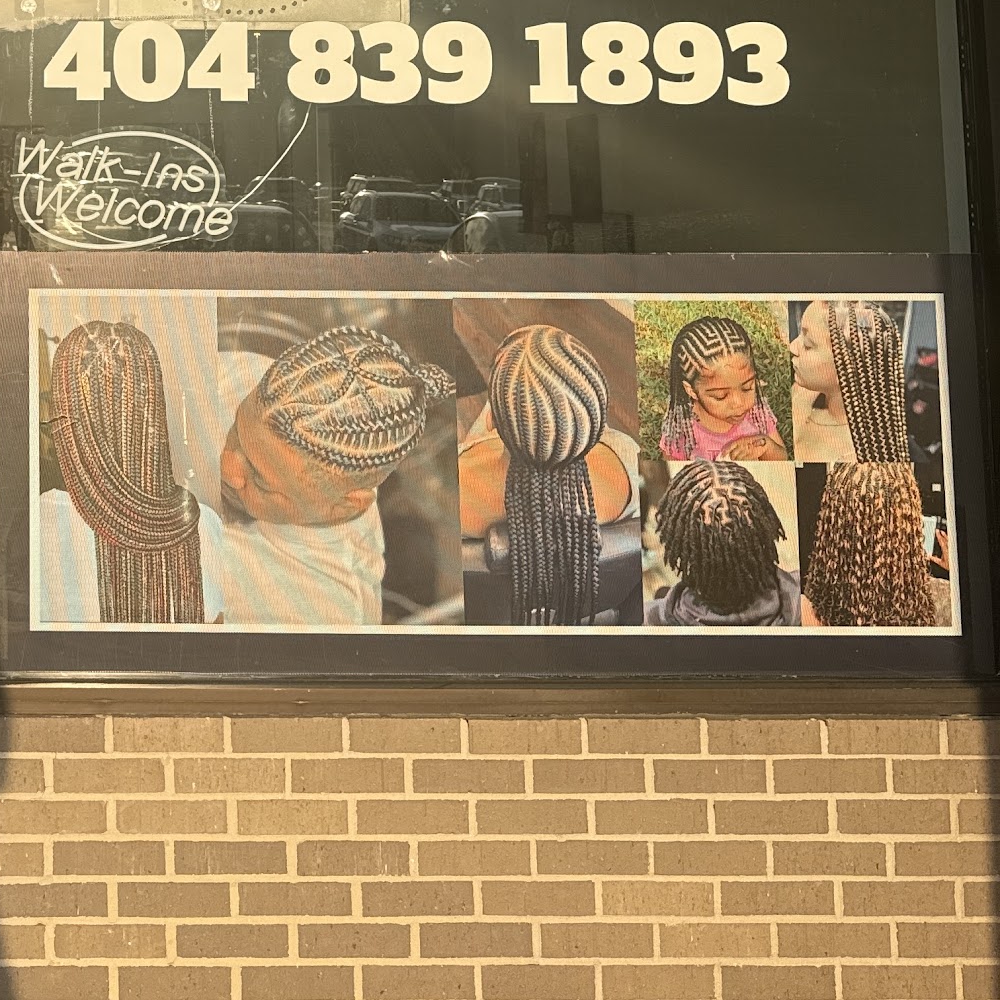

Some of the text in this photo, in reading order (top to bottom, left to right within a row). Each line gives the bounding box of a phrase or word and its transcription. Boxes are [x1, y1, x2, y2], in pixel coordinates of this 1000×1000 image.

[43, 20, 791, 106] 404 839 1893
[17, 137, 209, 193] Walk-Ins
[36, 180, 233, 236] Welcome
